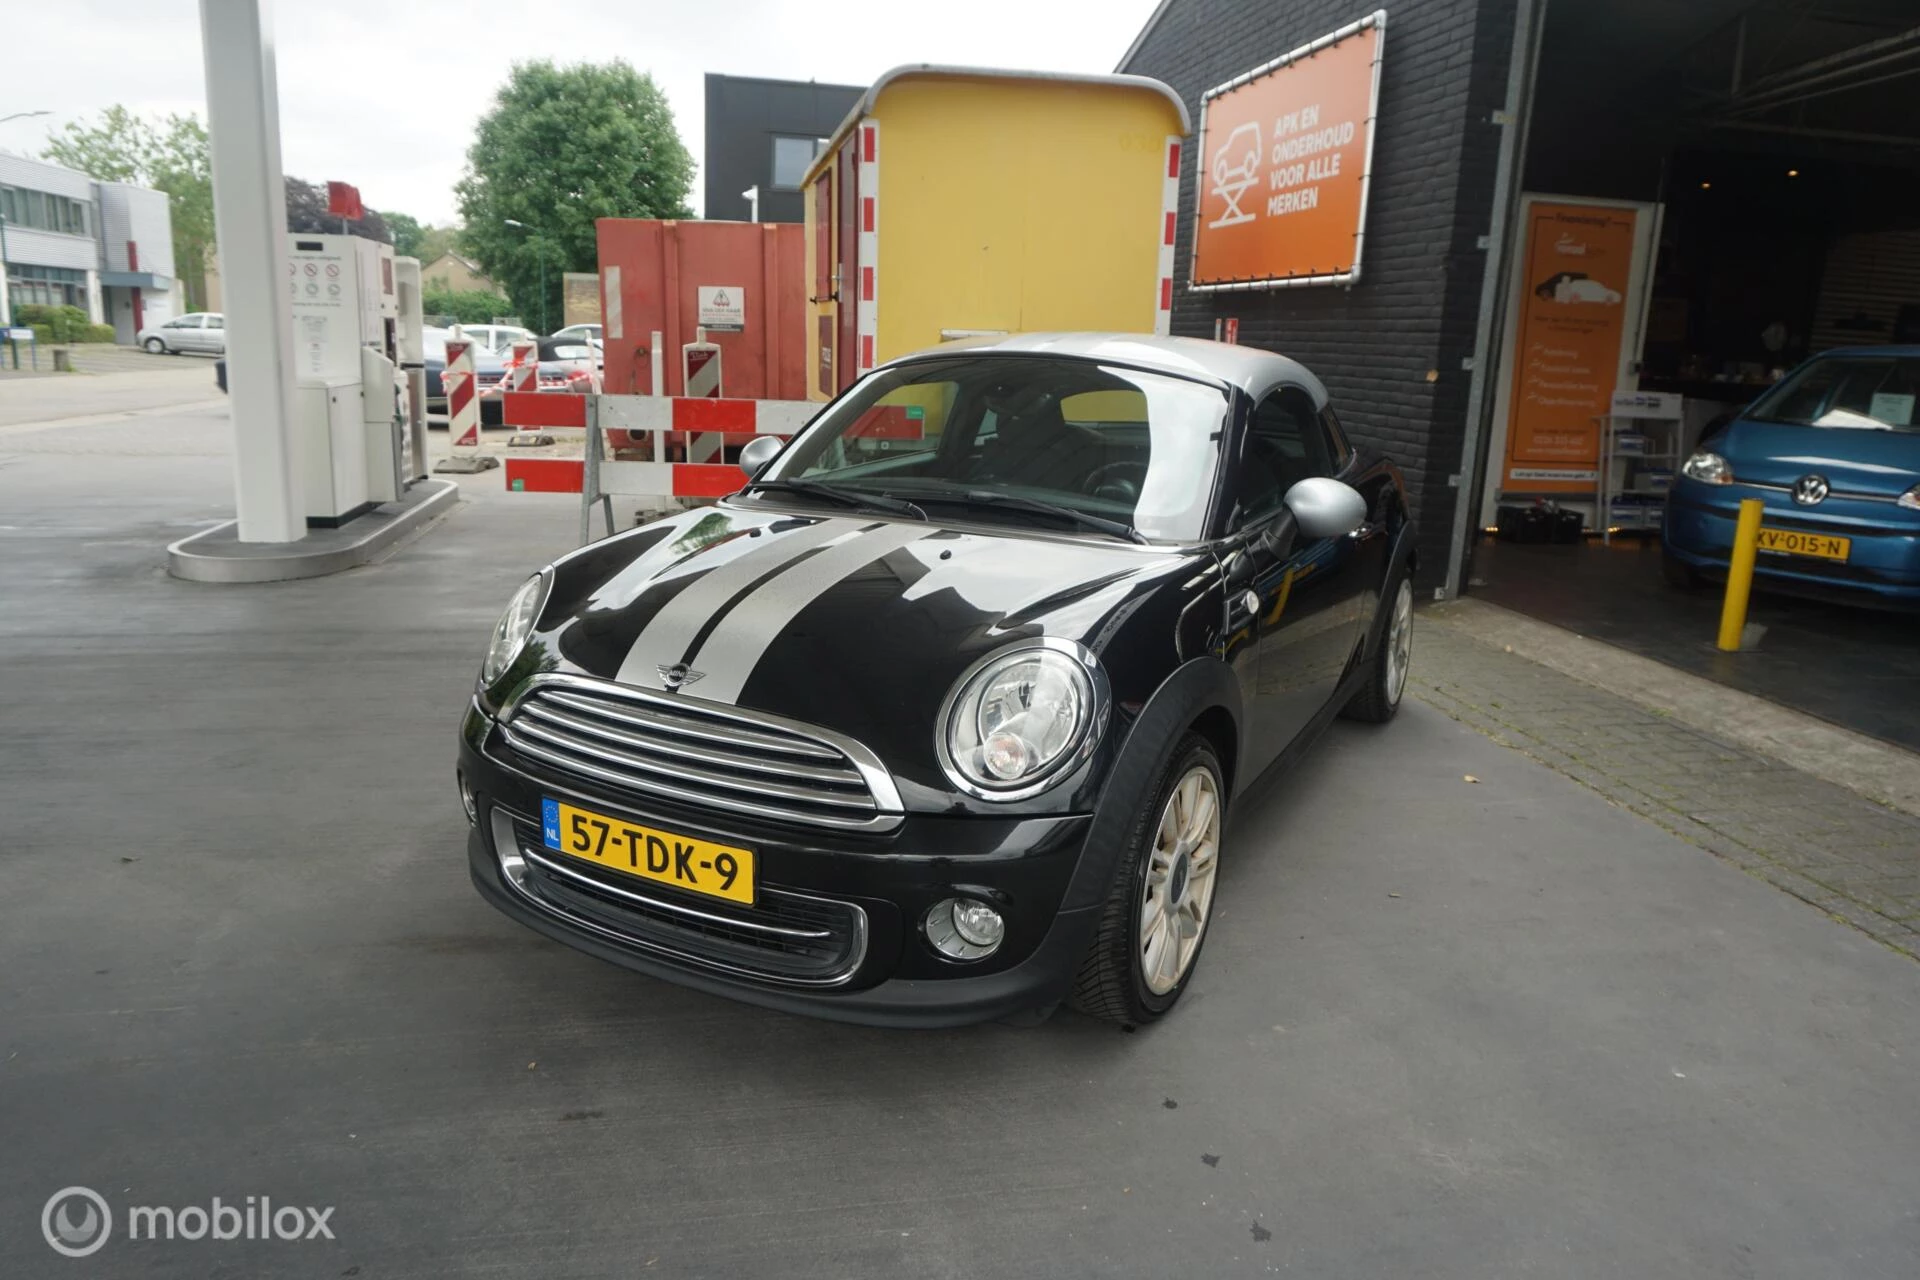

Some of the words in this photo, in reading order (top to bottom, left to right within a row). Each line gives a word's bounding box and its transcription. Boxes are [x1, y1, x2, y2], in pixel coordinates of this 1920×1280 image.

[1273, 111, 1298, 138] APK
[1301, 104, 1320, 128] EN
[1271, 121, 1355, 165] ONDERHOUD
[1270, 163, 1305, 190] VOOR
[1306, 153, 1342, 181] ALLE
[1266, 186, 1320, 217] MERKEN
[546, 827, 559, 842] NL
[571, 813, 738, 891] 57-TDK-9
